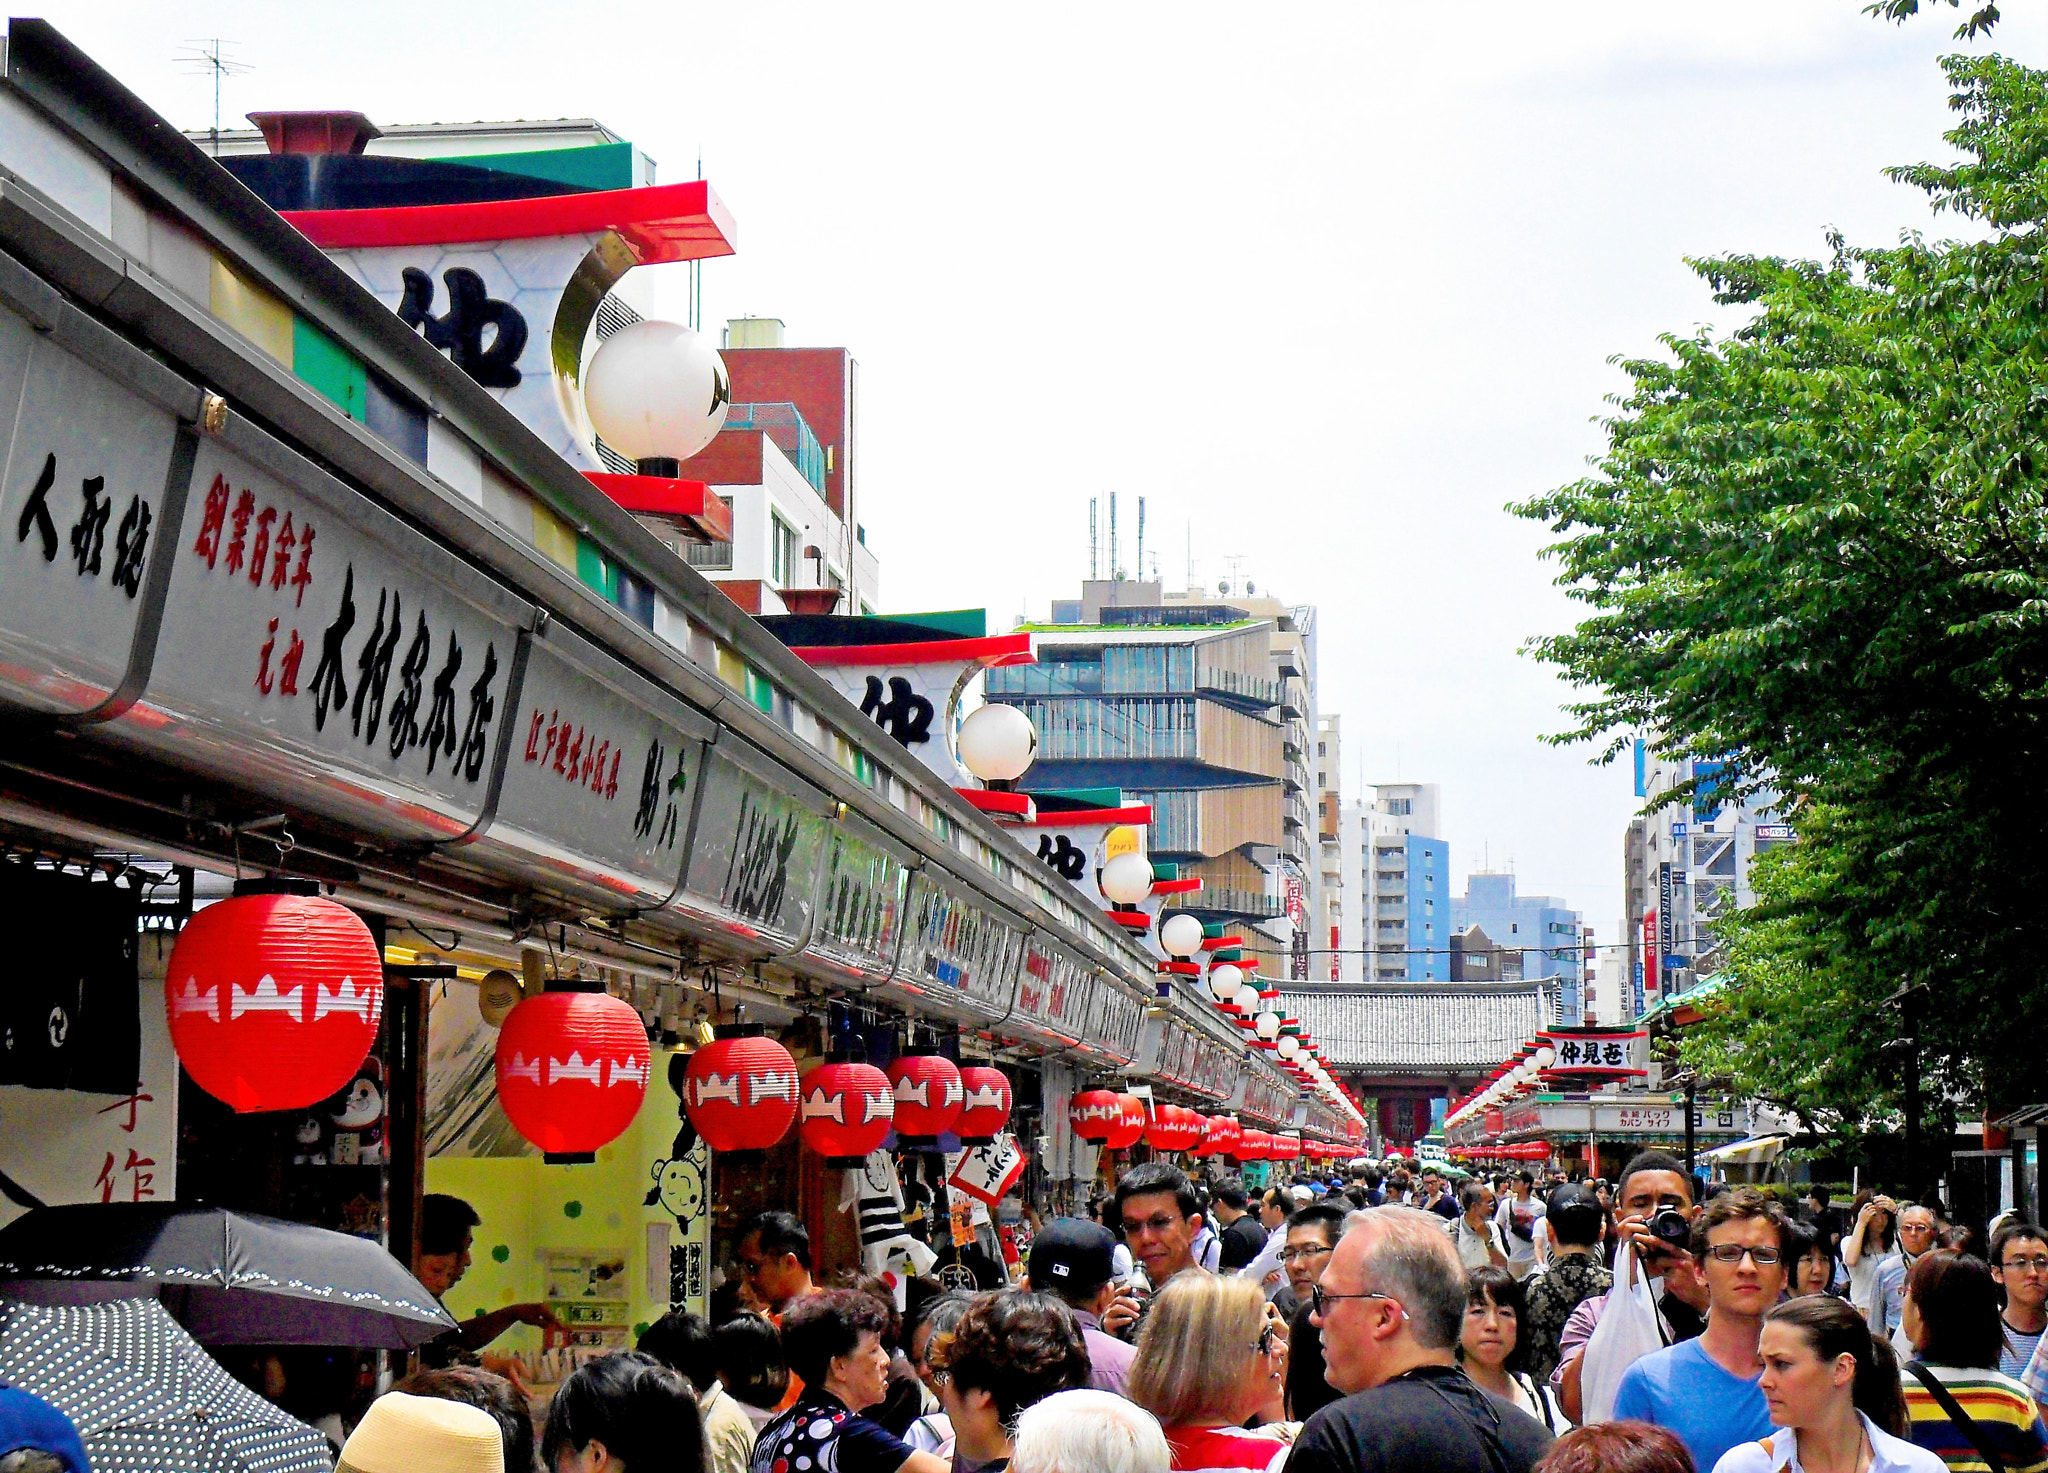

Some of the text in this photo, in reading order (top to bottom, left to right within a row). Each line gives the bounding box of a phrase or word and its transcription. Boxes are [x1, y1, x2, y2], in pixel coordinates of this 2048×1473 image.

[194, 472, 316, 608] 創業百余年
[307, 561, 498, 783] 木村家本店
[1560, 1040, 1623, 1066] 仲見世
